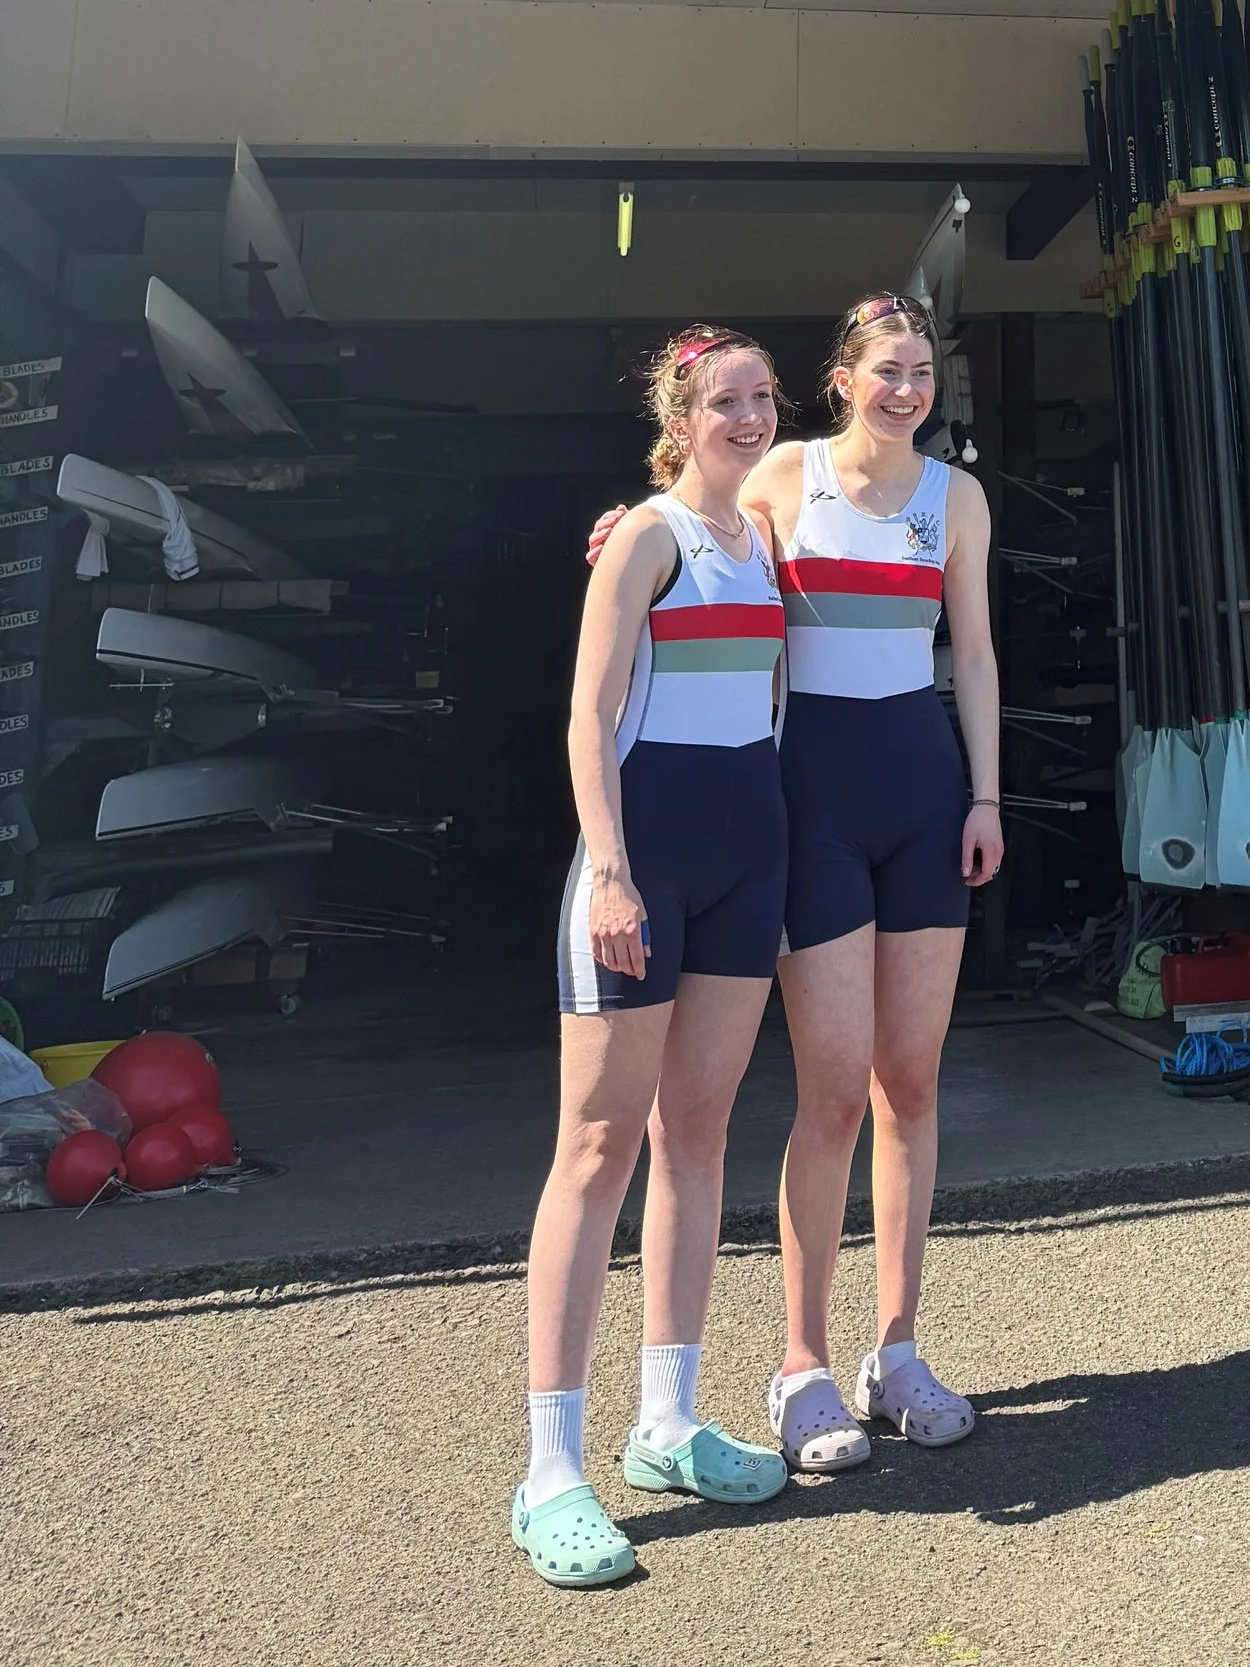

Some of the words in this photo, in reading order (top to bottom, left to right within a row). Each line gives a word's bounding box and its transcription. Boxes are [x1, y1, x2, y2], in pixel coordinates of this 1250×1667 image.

[3, 361, 44, 377] BLADES
[1, 407, 48, 425] HANDLES
[0, 457, 50, 474] BLADES
